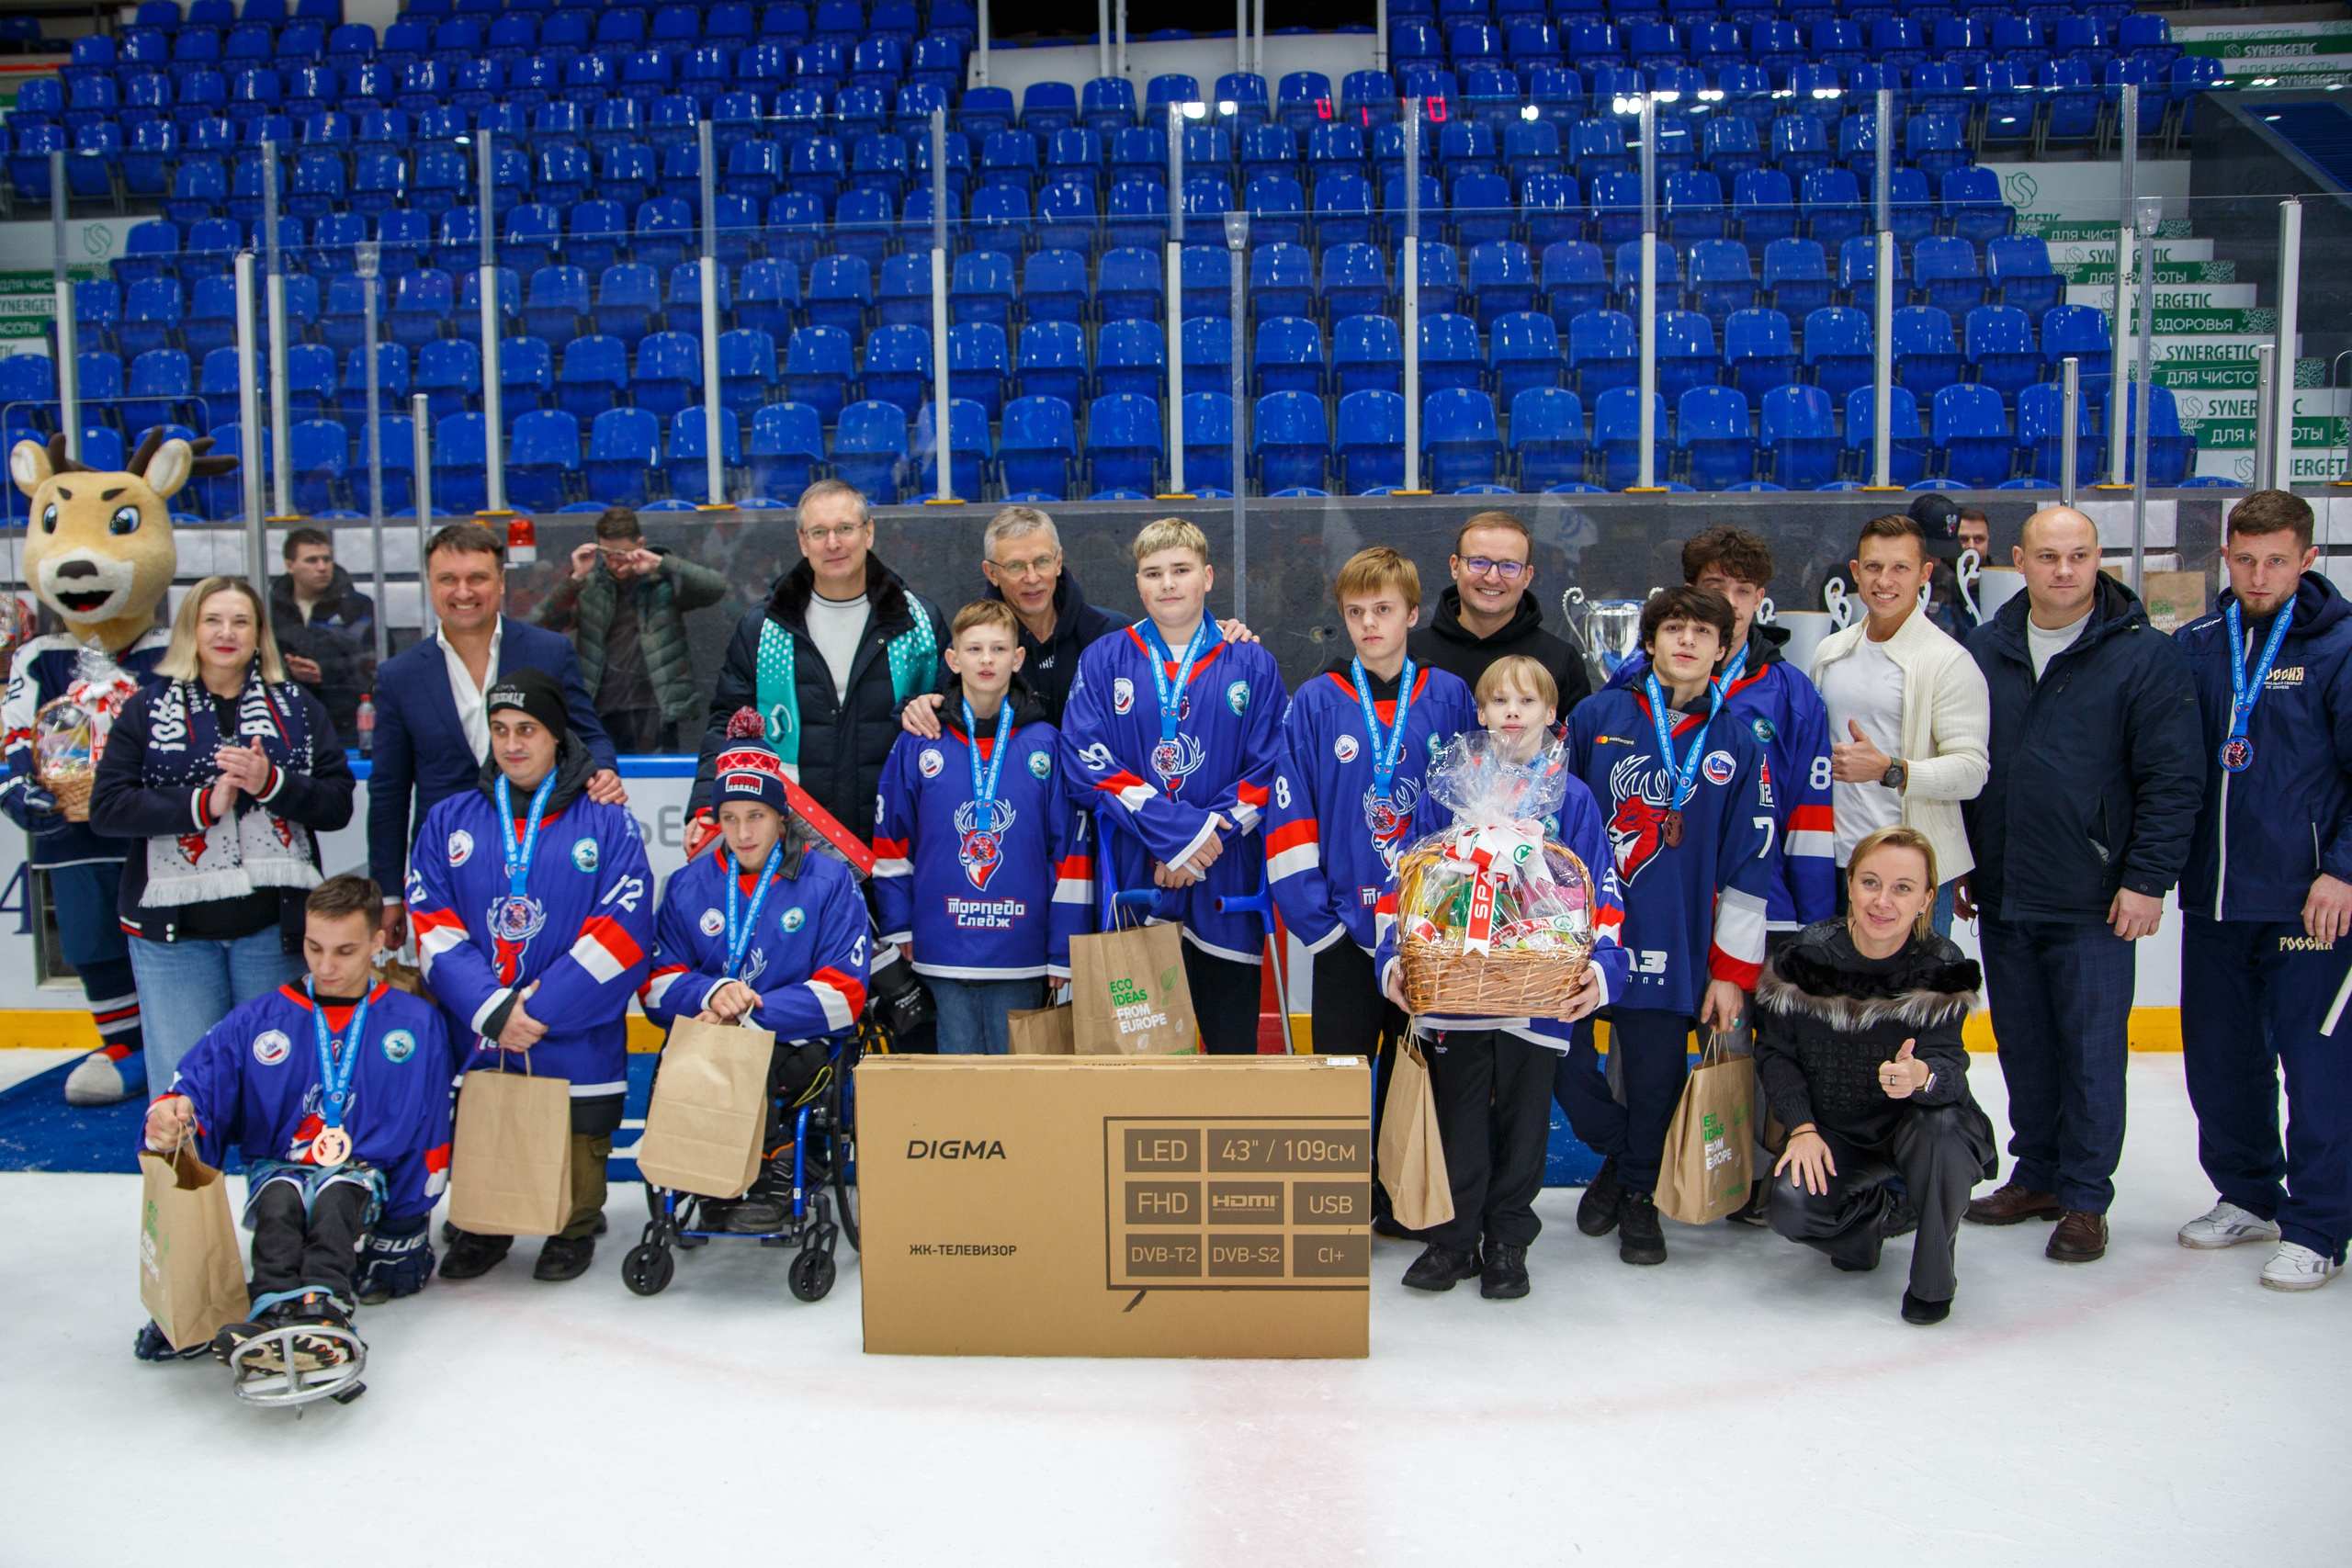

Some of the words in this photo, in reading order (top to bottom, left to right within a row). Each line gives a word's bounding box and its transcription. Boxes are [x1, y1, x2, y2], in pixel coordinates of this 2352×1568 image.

[2245, 42, 2318, 57] SYNERGETIC
[2051, 230, 2078, 241] ДЛЯ
[2154, 317, 2233, 332] ЗДОРОВЬЯ
[2166, 344, 2256, 361] SYNERGETIC
[2166, 371, 2198, 385] ДЛЯ
[2211, 429, 2245, 444] ДЛЯ
[1609, 737, 1634, 745] mastercard
[729, 775, 761, 788] RUSSIA
[1810, 756, 1832, 790] 8
[1275, 775, 1292, 809] 8
[1753, 817, 1774, 858] 7
[600, 874, 644, 913] 12
[947, 897, 1024, 916] Торпедо
[957, 914, 1011, 928] Следж
[1110, 978, 1133, 993] ECO
[1113, 988, 1148, 1007] IDEAS
[1116, 1003, 1151, 1021] FROM
[1119, 1012, 1168, 1034] EUROPE
[906, 1140, 1006, 1160] DIGMA
[1138, 1140, 1188, 1162] LED
[1222, 1139, 1259, 1162] 43"
[1138, 1193, 1188, 1214] FHD
[1310, 1196, 1353, 1214] USB
[910, 1245, 1017, 1257] ЖК-ТЕЛЕВИЗОР
[1132, 1247, 1196, 1264] DVB-T2
[1213, 1247, 1280, 1264] DVB-S2
[1317, 1247, 1345, 1264] CI+
